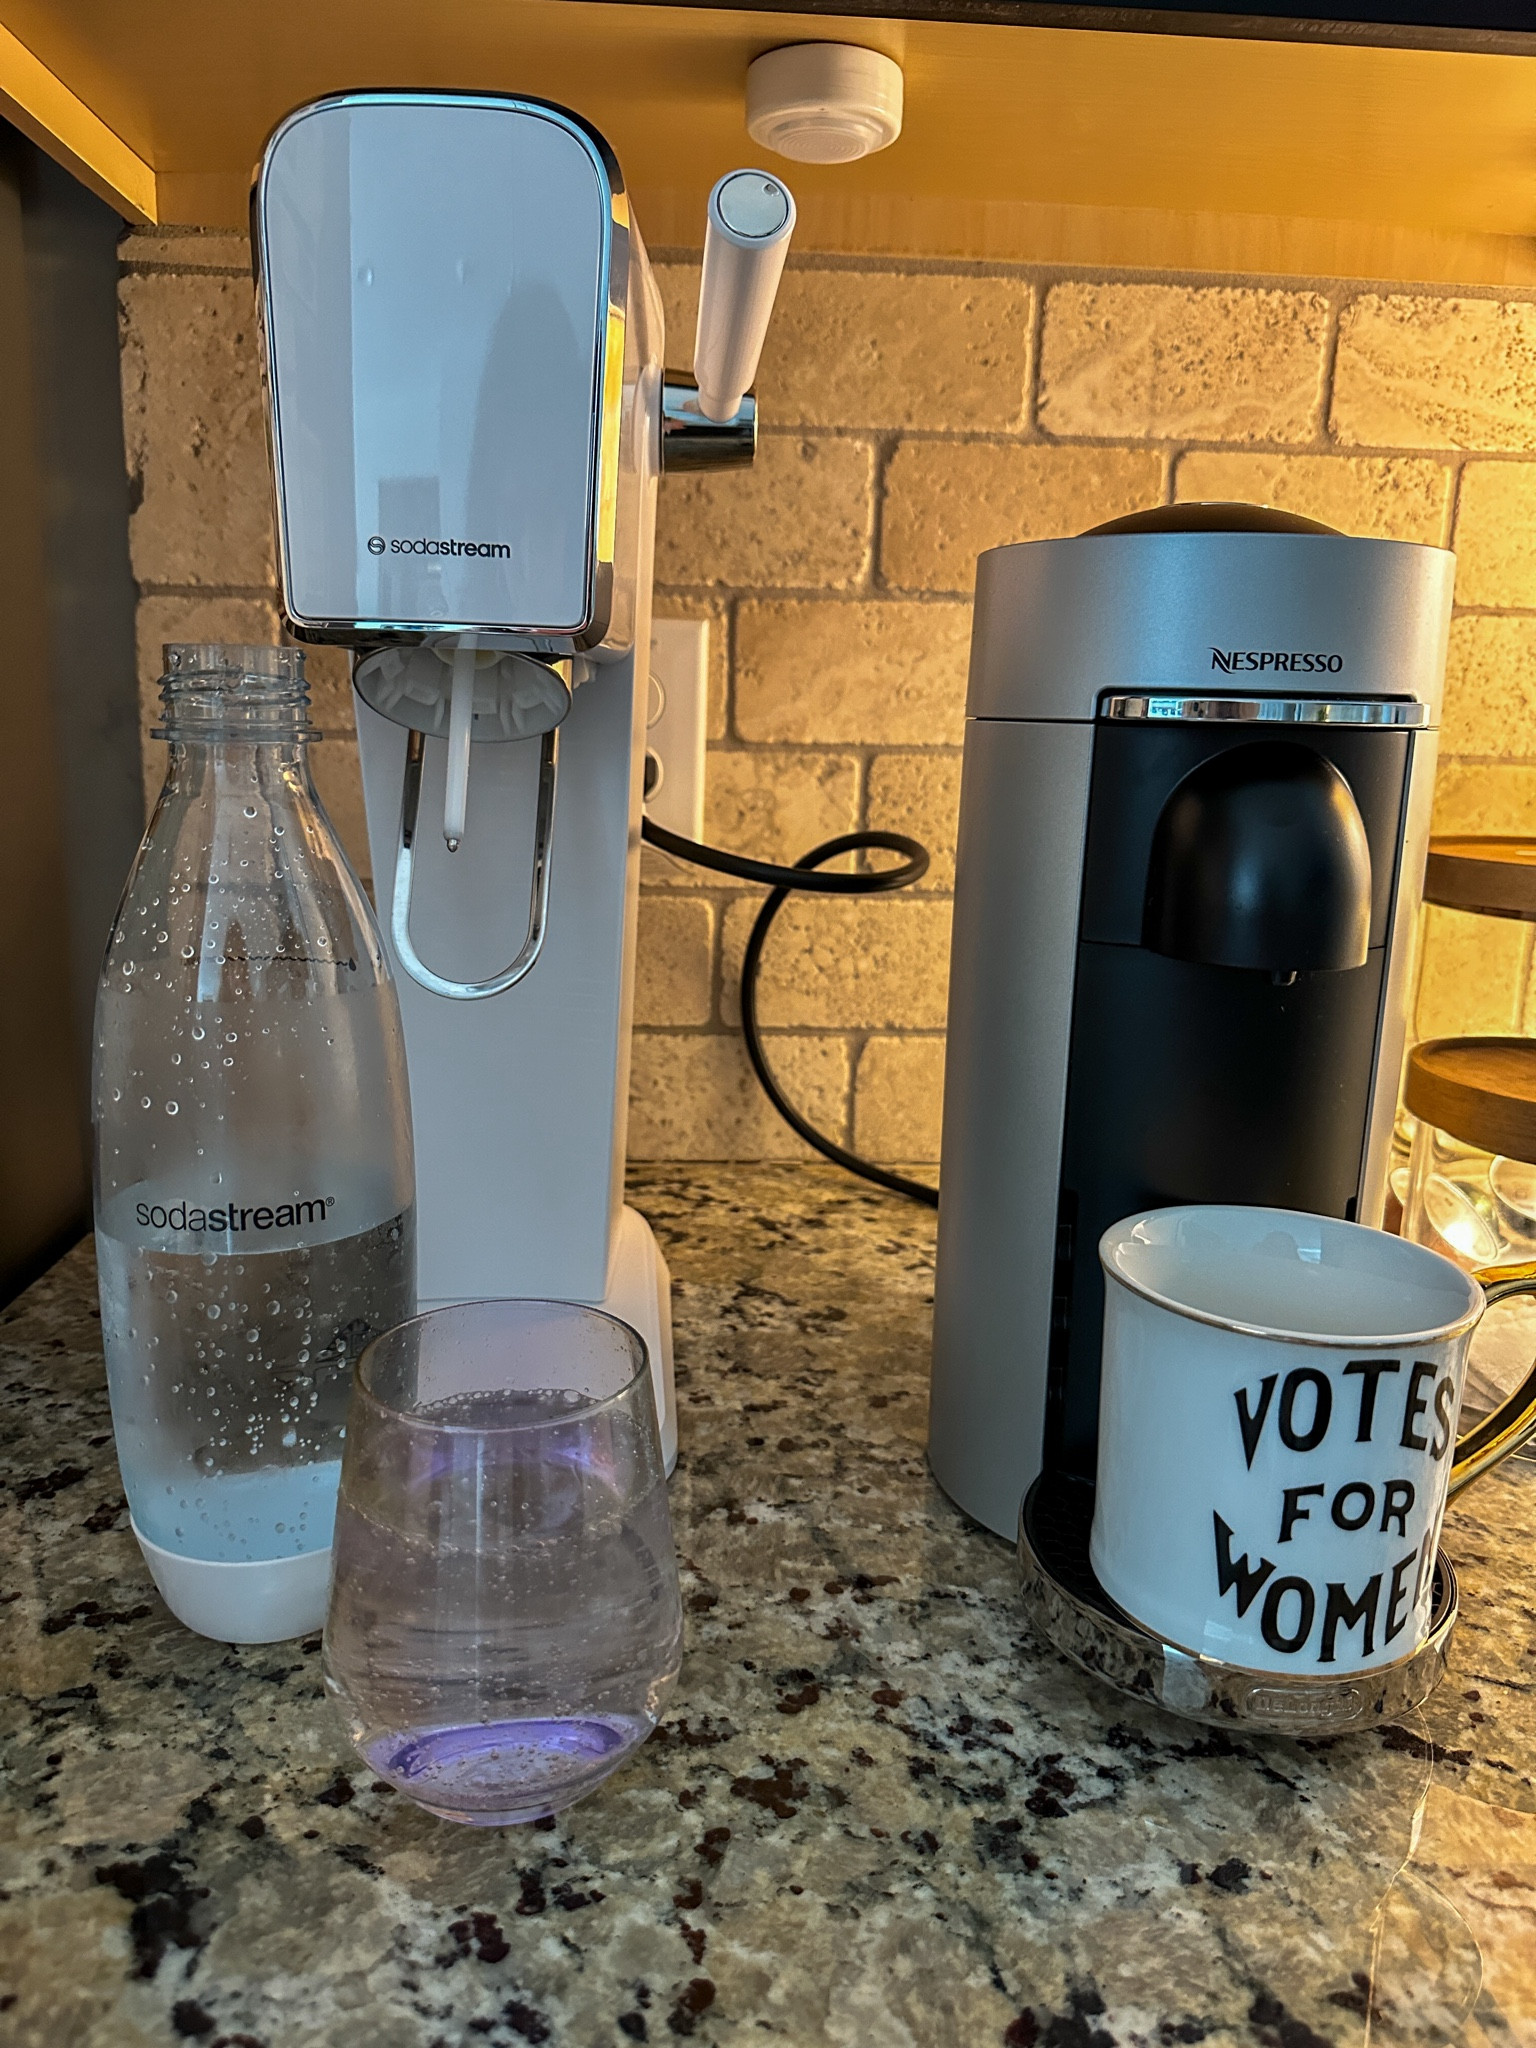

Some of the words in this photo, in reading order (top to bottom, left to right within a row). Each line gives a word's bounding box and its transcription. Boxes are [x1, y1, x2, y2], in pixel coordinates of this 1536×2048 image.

[390, 538, 511, 559] sodastream
[1208, 647, 1343, 675] NESPRESSO
[1234, 1359, 1455, 1472] VOTES
[1277, 1479, 1415, 1544] FOR
